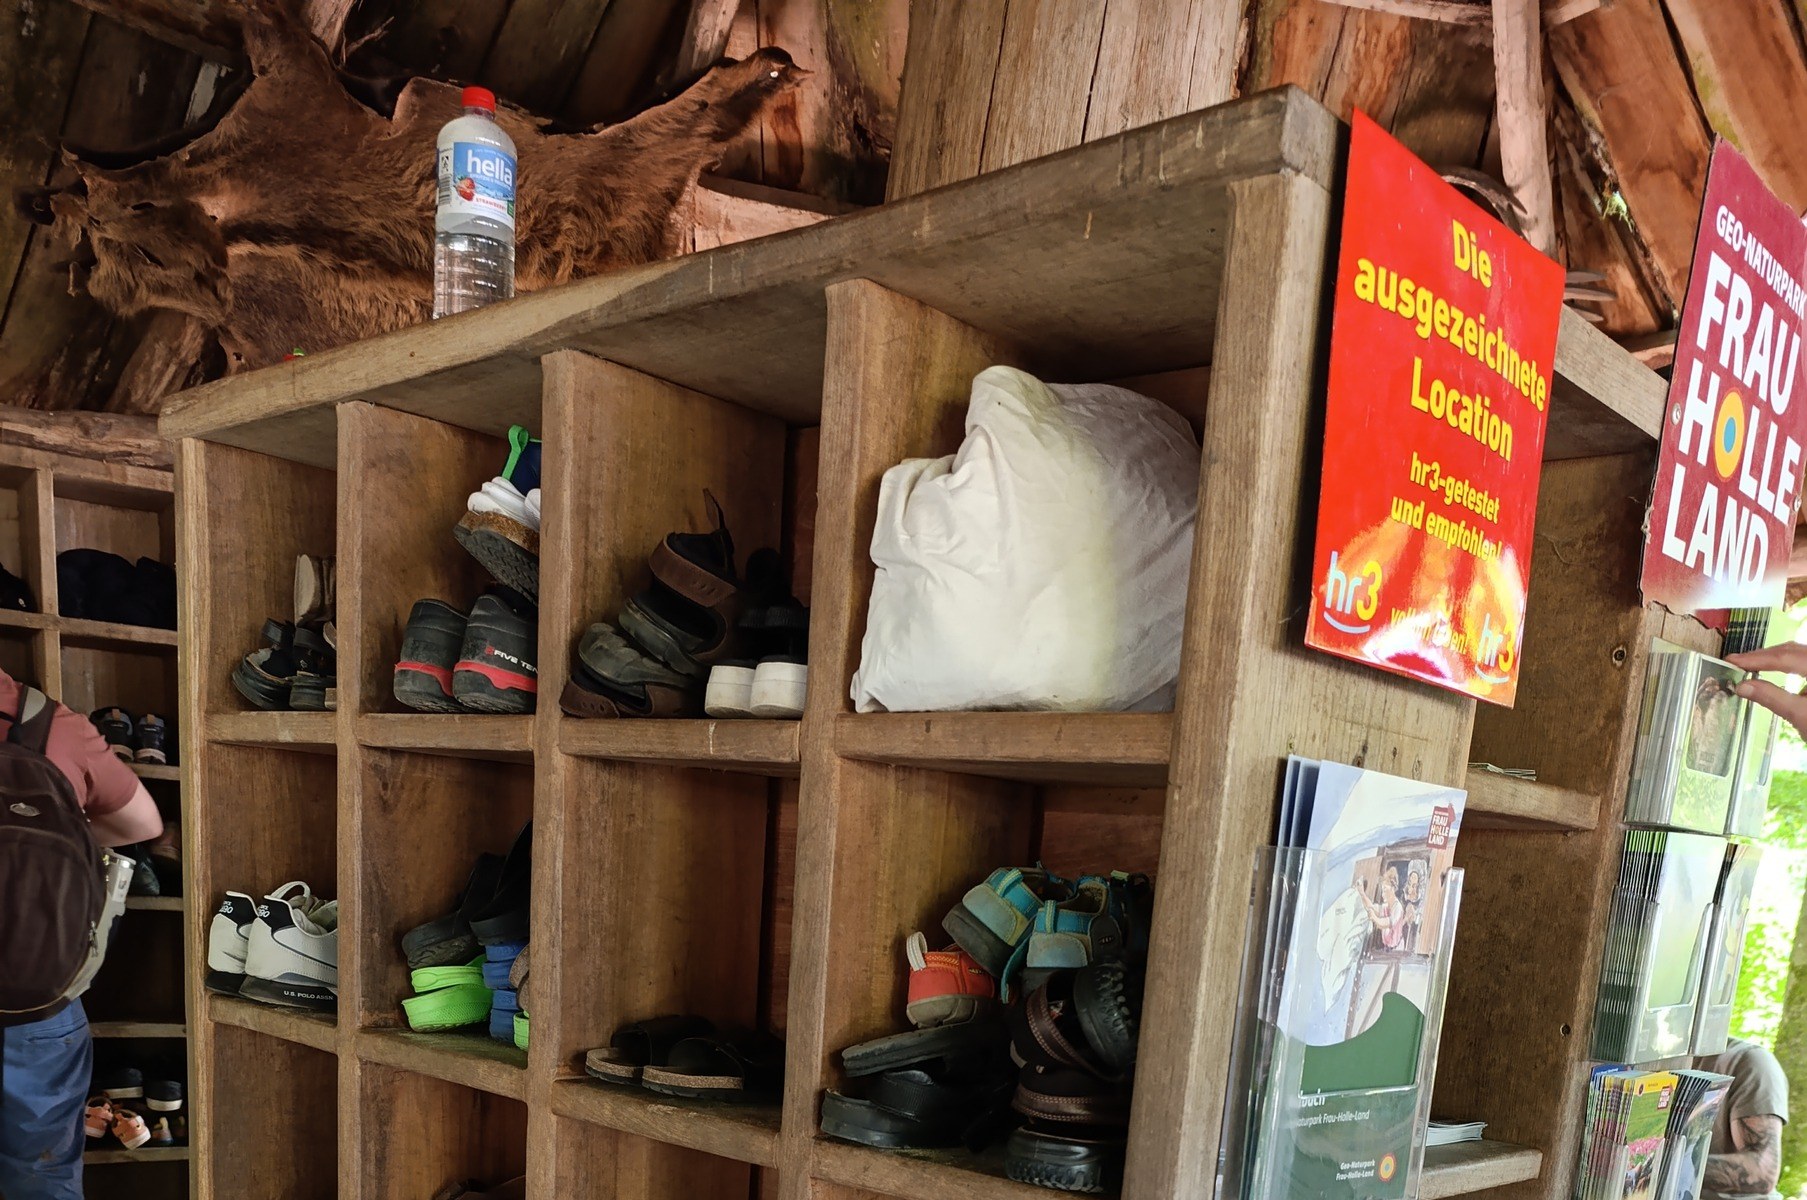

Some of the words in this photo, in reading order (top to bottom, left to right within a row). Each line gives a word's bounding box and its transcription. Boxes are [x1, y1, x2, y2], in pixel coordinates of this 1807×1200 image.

[467, 149, 513, 187] hella
[1452, 218, 1492, 288] Die
[1716, 205, 1807, 320] GEO-NATURPARK
[1354, 257, 1547, 412] ausgezeichnete
[1697, 251, 1801, 415] FRAU
[1411, 356, 1513, 462] Location
[1678, 357, 1801, 526] HOLLE
[1410, 451, 1500, 525] hr3-getestet
[1391, 496, 1425, 530] und
[1426, 512, 1503, 562] empfohlen!
[1662, 462, 1769, 591] LAND
[1325, 551, 1382, 621] hr3
[494, 649, 518, 665] FIVE
[1477, 613, 1515, 673] hr3
[1428, 834, 1445, 845] LAND
[1432, 814, 1448, 827] FRAU
[1322, 1109, 1371, 1124] Frau-Holle-Land
[1335, 1169, 1375, 1181] Frau-Holle-Land
[1340, 1158, 1376, 1171] Geo-Naturpark
